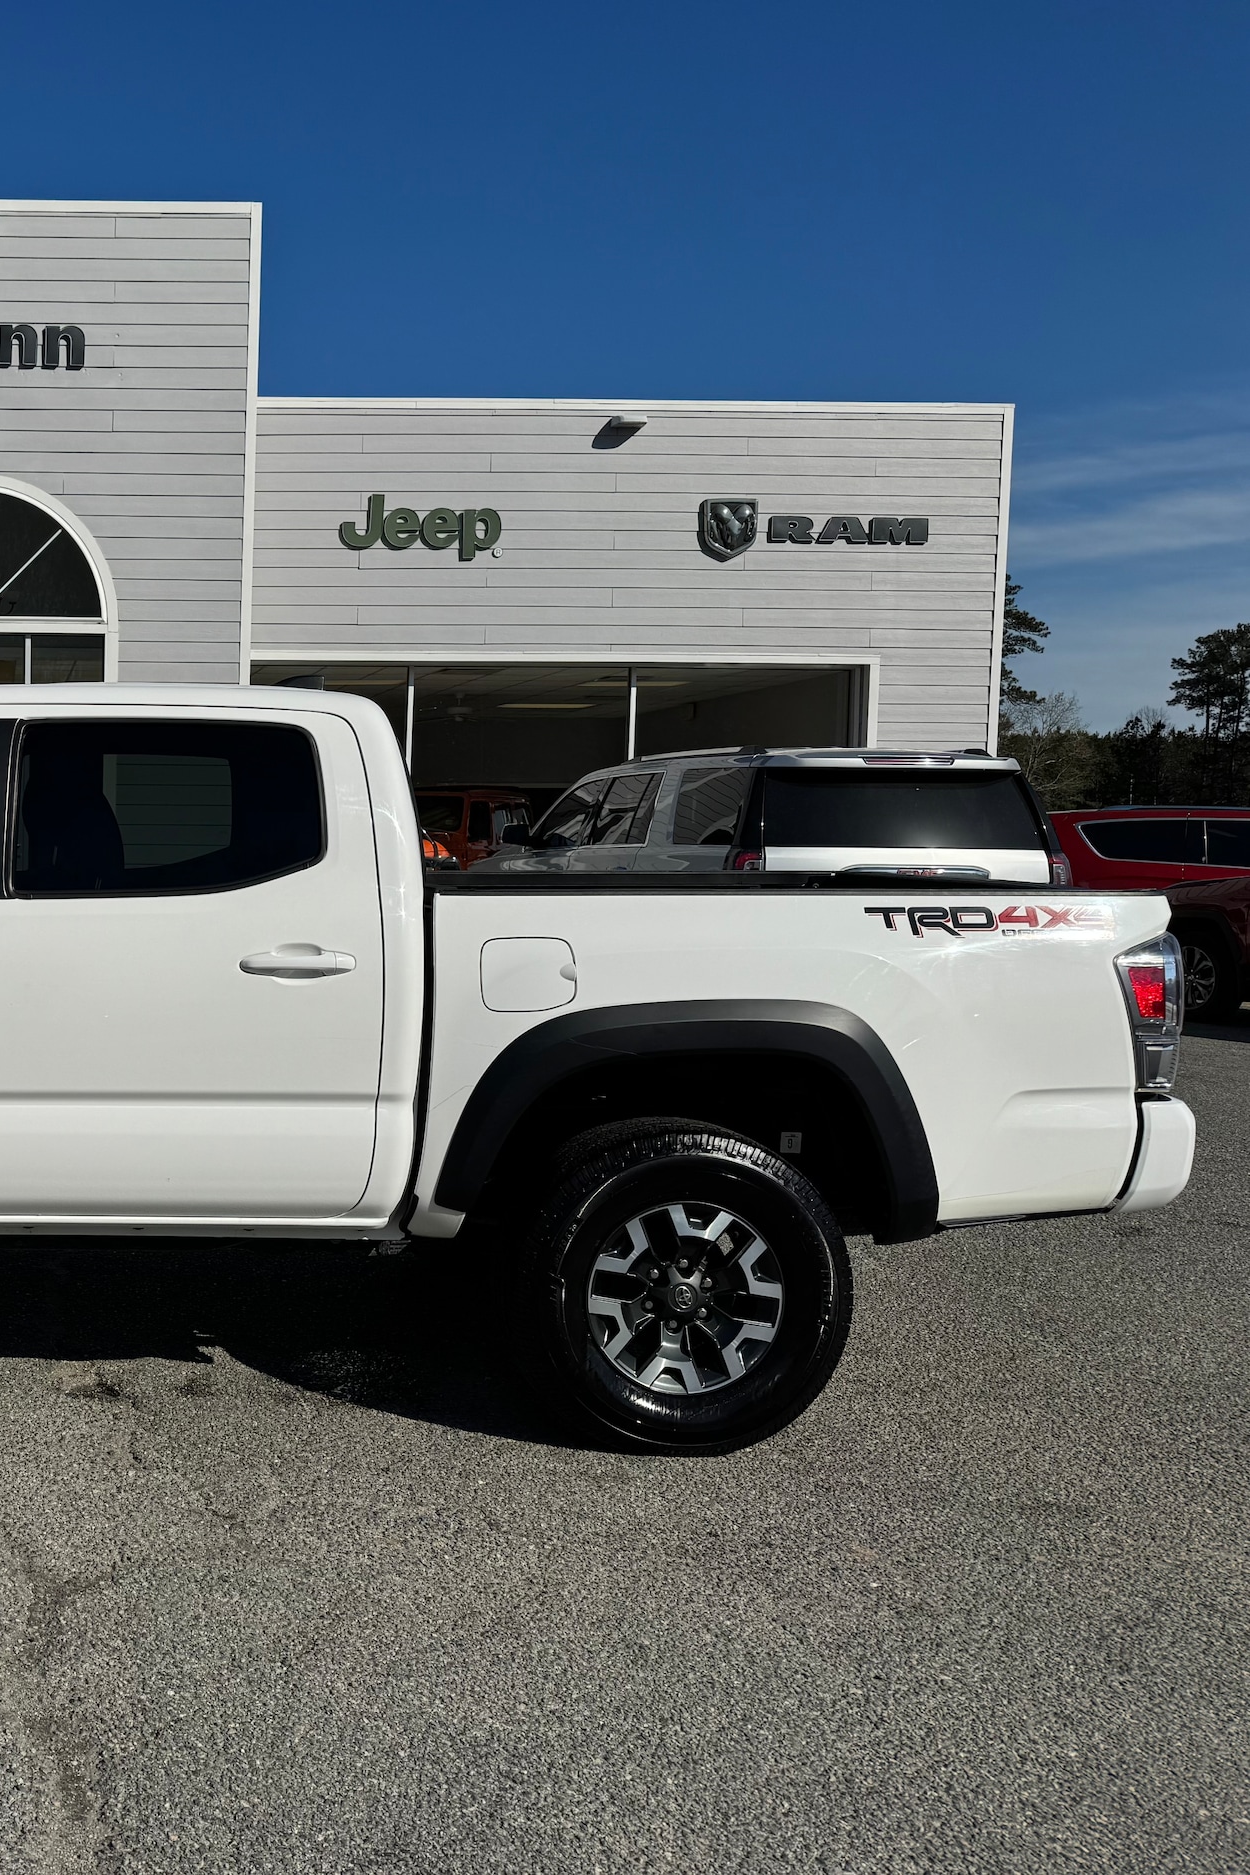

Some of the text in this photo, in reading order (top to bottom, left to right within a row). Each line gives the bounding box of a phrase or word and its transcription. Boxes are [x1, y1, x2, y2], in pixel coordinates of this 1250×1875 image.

[338, 494, 502, 562] Jeep
[767, 516, 929, 545] RAM
[864, 906, 998, 938] TRD
